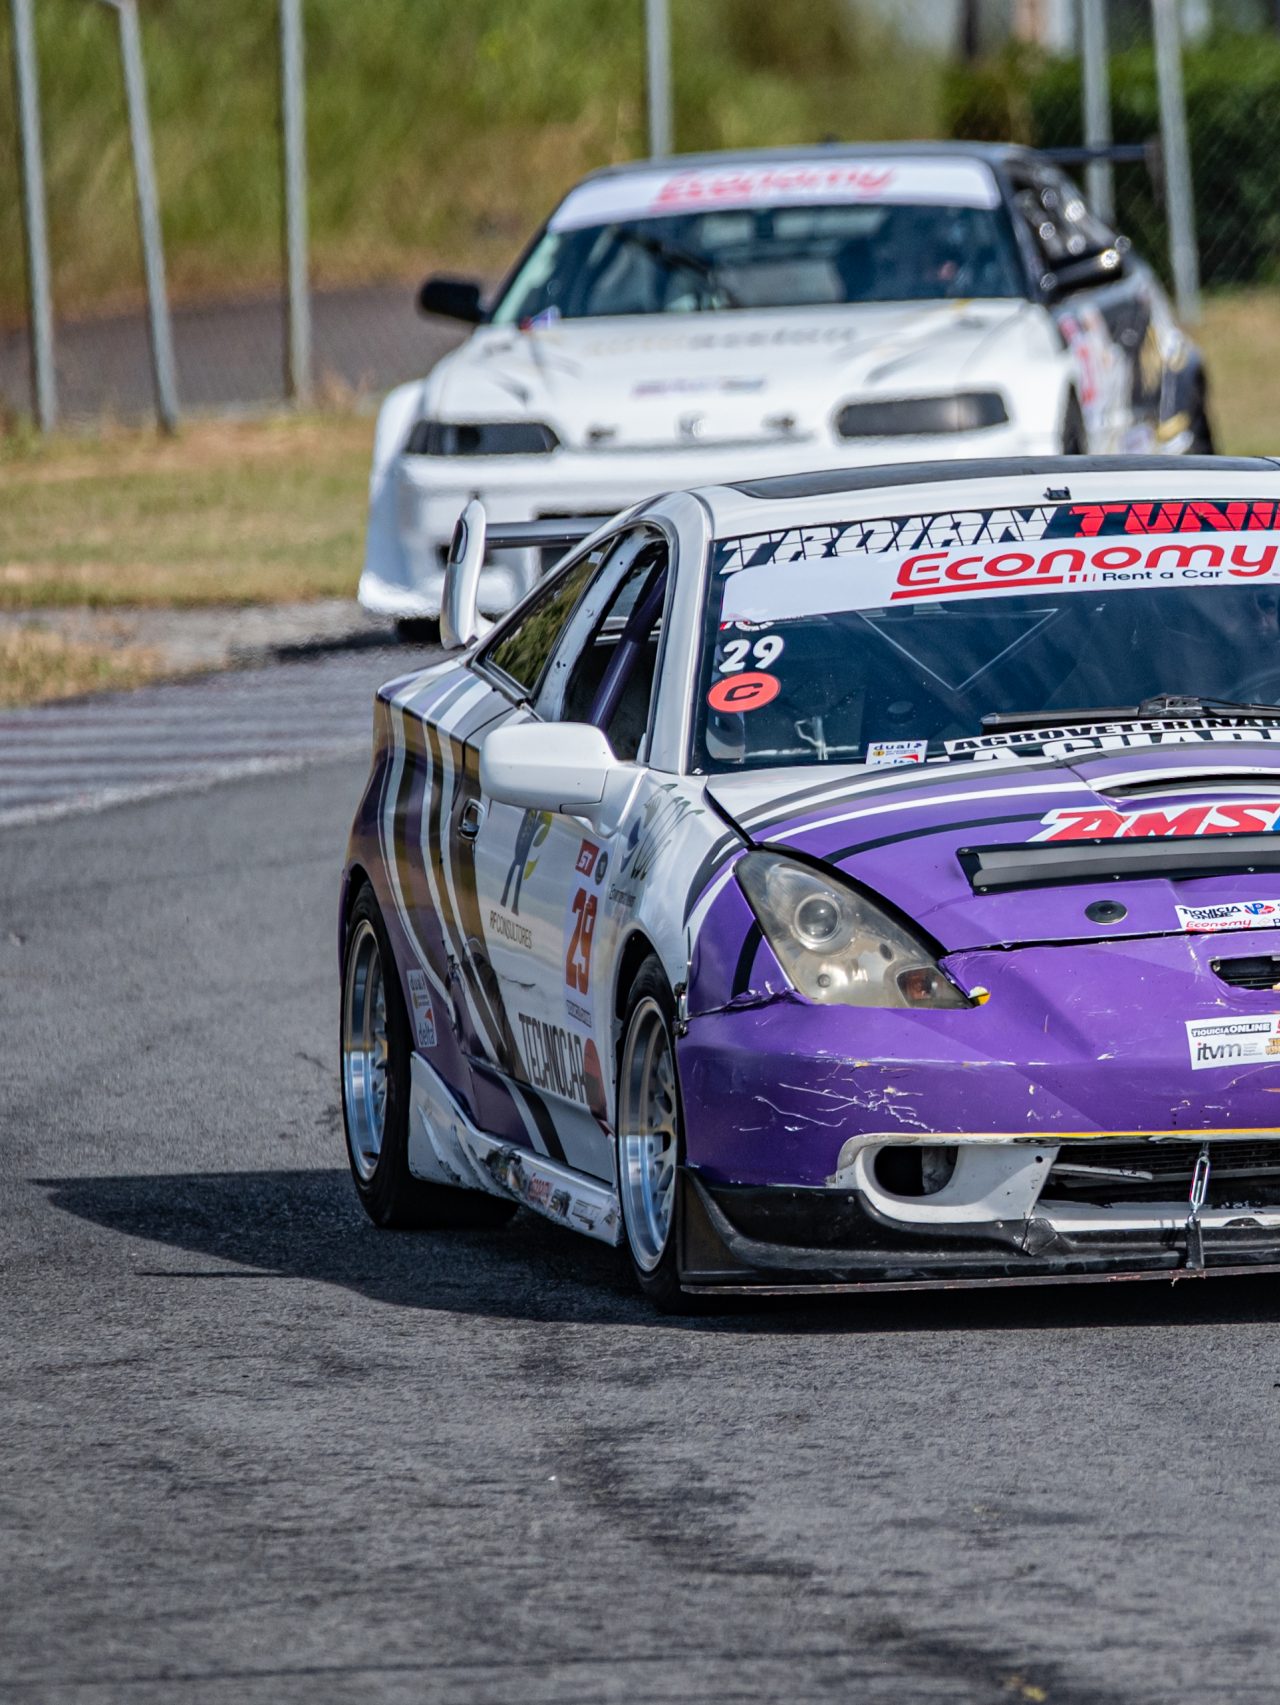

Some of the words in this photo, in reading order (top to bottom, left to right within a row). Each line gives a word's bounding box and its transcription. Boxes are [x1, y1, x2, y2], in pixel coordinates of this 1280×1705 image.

[895, 545, 1279, 588] Economy
[1102, 571, 1153, 582] Rent
[1182, 569, 1223, 579] Car
[719, 635, 784, 673] 29
[723, 682, 764, 702] C
[1186, 920, 1252, 929] Economy
[566, 887, 598, 995] 29
[518, 1012, 587, 1104] TECHNOCAR
[1197, 1042, 1242, 1061] itvm
